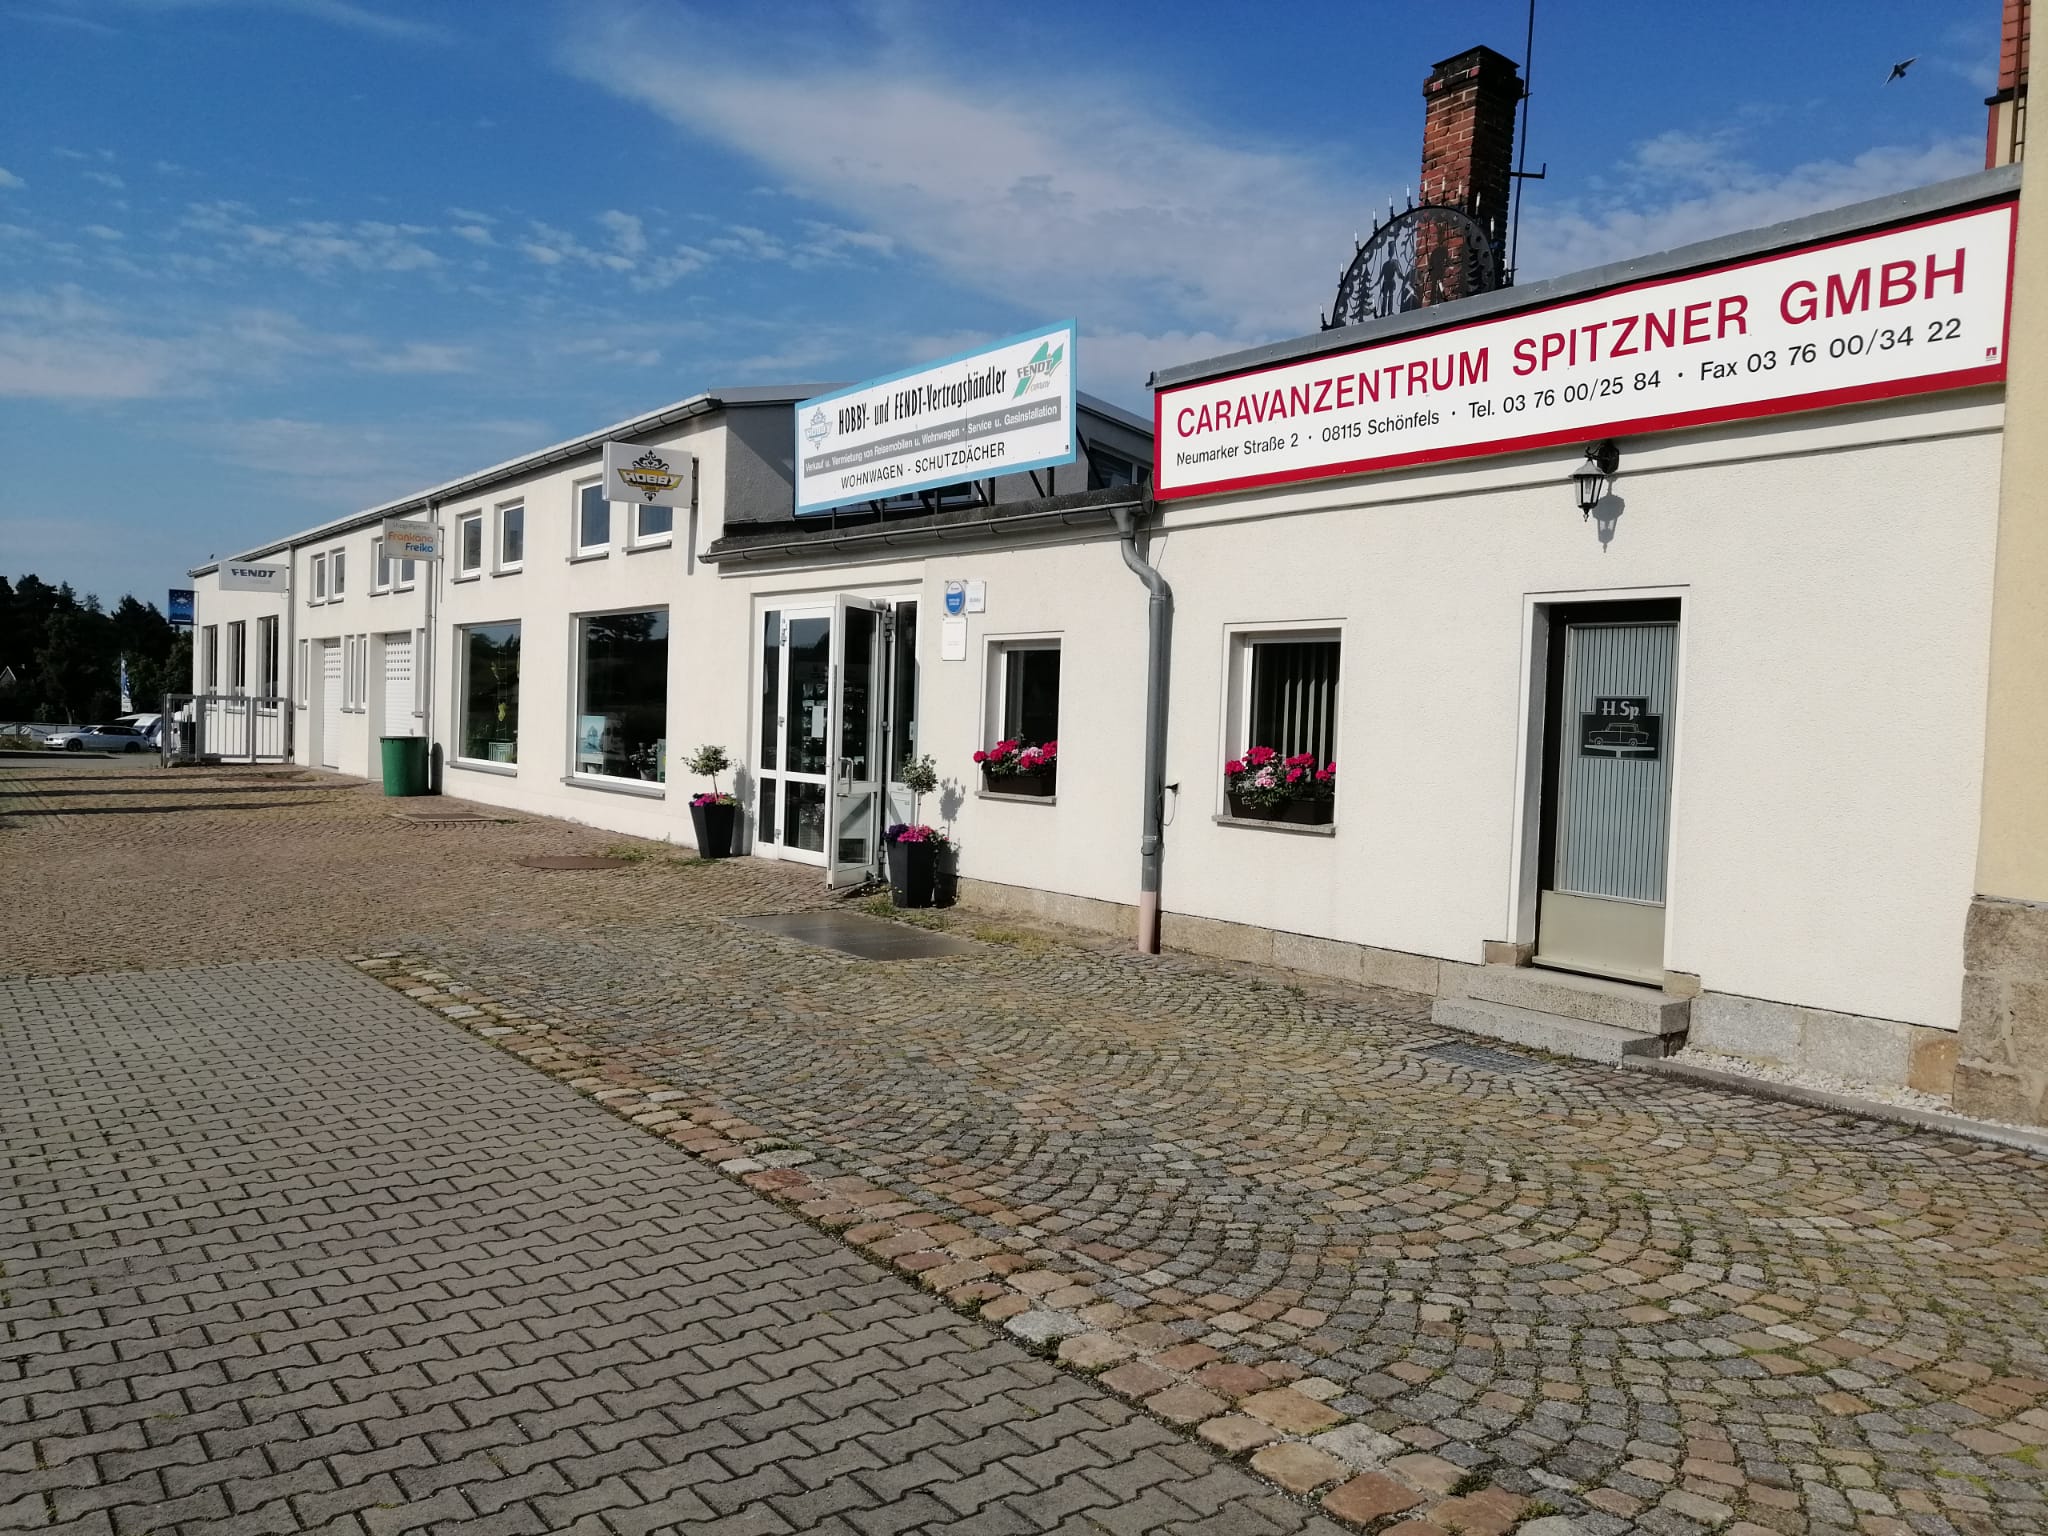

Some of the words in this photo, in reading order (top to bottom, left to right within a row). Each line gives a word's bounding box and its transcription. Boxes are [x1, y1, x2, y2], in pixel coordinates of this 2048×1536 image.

[1177, 348, 1489, 438] CARAVANZENTRUM
[1512, 295, 1748, 377] SPITZNER
[1779, 248, 1966, 325] GMBH
[1017, 359, 1053, 378] FENDT
[838, 402, 870, 436] HOBBY-
[874, 395, 890, 426] und
[894, 365, 1007, 421] FENDT-Vertragshändler
[1177, 446, 1240, 466] Neumarker
[1243, 436, 1285, 455] Straße
[1290, 432, 1299, 448] 2
[1322, 421, 1362, 443] 08115
[1367, 409, 1440, 435] Schönfels
[1468, 399, 1495, 418] Tel.
[1502, 394, 1526, 414] 03
[1533, 388, 1555, 409] 76
[1563, 376, 1624, 403] 00/25
[1633, 369, 1662, 391] 84
[1700, 361, 1738, 381] Fax
[1746, 350, 1777, 373] 03
[1788, 343, 1817, 367] 76
[1829, 325, 1914, 359] 00/34
[1927, 317, 1962, 343] 22
[831, 452, 863, 466] Vermietung
[863, 449, 874, 458] von
[874, 439, 913, 456] Reisemobilen
[921, 427, 960, 445] Wohnwagen
[967, 419, 992, 434] Service
[994, 418, 1002, 428] u.
[1004, 404, 1058, 426] Gasinstallation
[622, 471, 678, 486] HOBBY
[840, 463, 904, 489] WOHNWAGEN
[915, 441, 1005, 474] SCHUTZDÄCHER
[388, 531, 434, 543] Frankana
[405, 542, 434, 553] Freiko
[231, 568, 277, 578] FENDT
